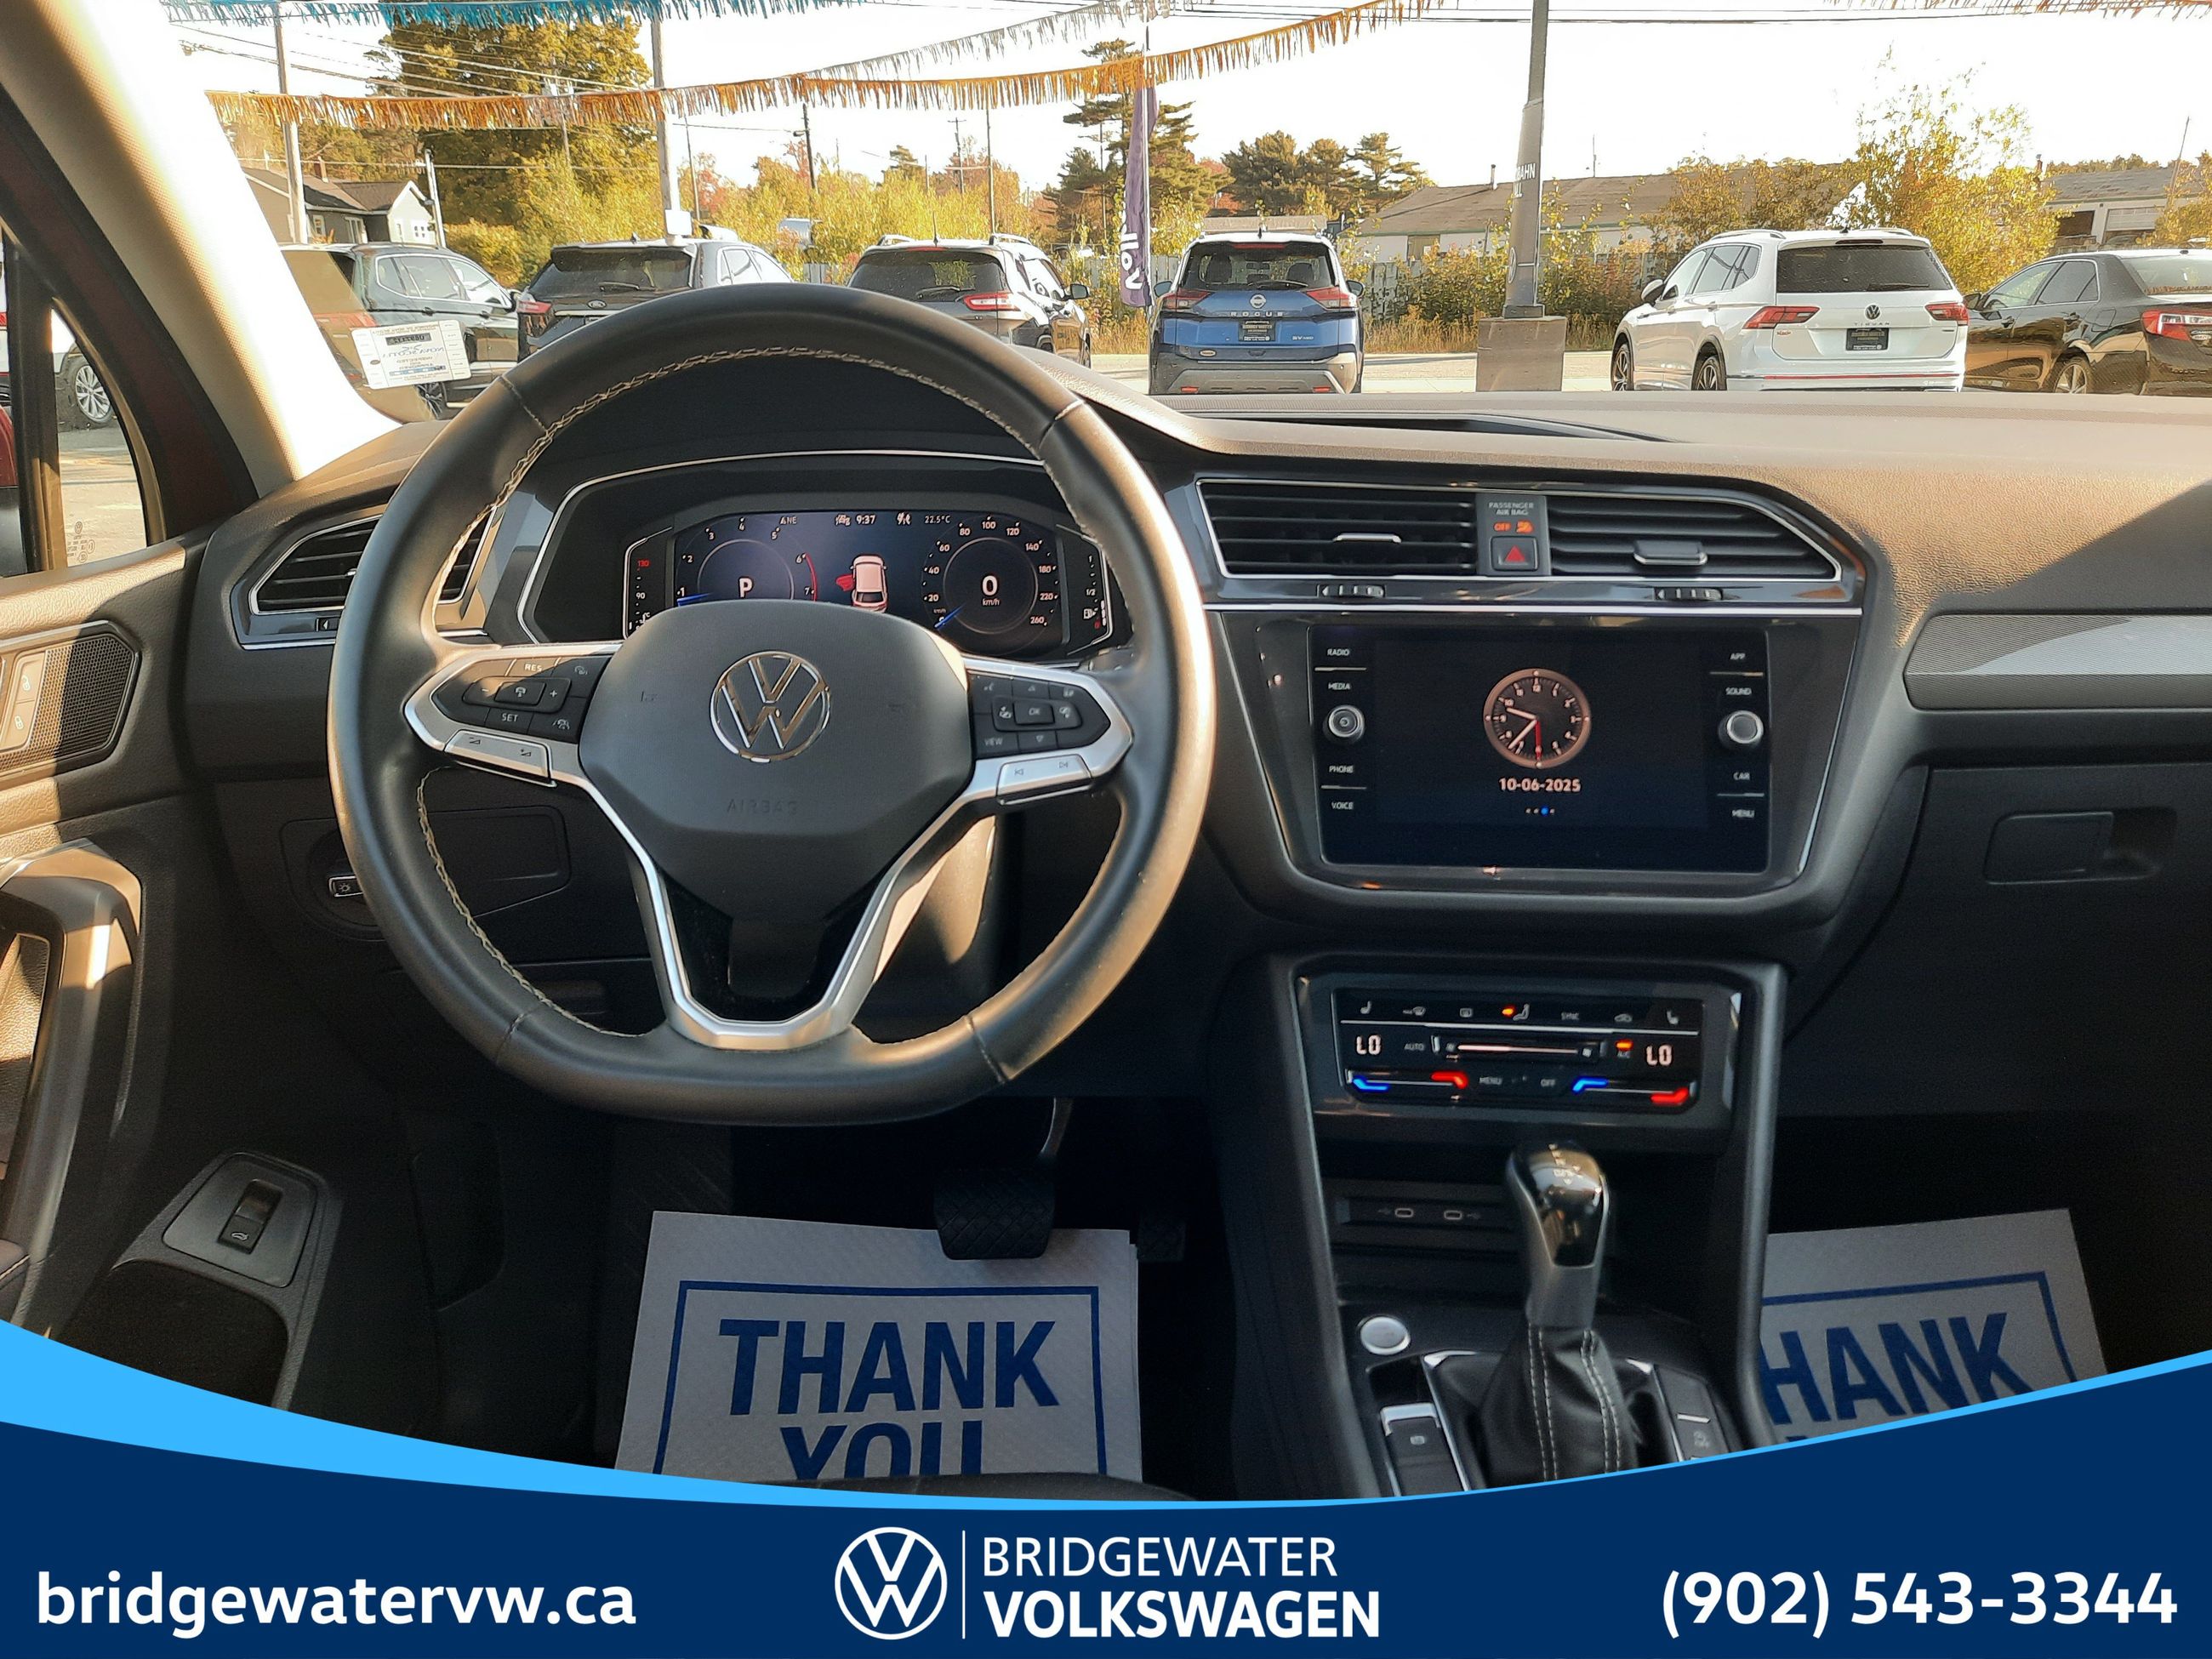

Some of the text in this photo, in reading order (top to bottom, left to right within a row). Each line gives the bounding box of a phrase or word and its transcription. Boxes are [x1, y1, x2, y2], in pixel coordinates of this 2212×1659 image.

[856, 514, 876, 525] 9:37
[924, 515, 951, 525] 22.5°C
[982, 521, 996, 529] 100
[1493, 522, 1511, 532] OFF
[709, 532, 715, 540] 3
[771, 532, 778, 540] 5
[959, 527, 971, 536] 80
[1006, 527, 1020, 536] 120
[939, 544, 950, 552] 60
[1025, 542, 1040, 551] 140
[687, 555, 693, 563] 2
[928, 566, 940, 574] 40
[738, 578, 754, 598] P
[982, 575, 998, 596] 0
[636, 591, 646, 600] 90
[927, 594, 939, 602] 20
[1040, 592, 1053, 601] 220
[982, 597, 1001, 607] km/h
[1327, 648, 1350, 657] RADIO
[1730, 653, 1746, 661] APP
[524, 664, 542, 672] RES
[1725, 687, 1753, 696] SOUND
[1028, 707, 1041, 716] OK
[501, 713, 519, 722] SET
[984, 737, 1004, 746] VIEW
[1733, 772, 1751, 781] CAR
[1498, 778, 1582, 792] 10-06-2025
[1331, 801, 1354, 810] VOICE
[1732, 810, 1755, 818] MENU
[1560, 1012, 1579, 1021] SYNC
[1355, 1035, 1382, 1056] LO
[1645, 1044, 1673, 1066] LO
[1479, 1077, 1503, 1086] MENU
[1540, 1078, 1556, 1087] OFF
[719, 1319, 1060, 1416] THANK
[1759, 1312, 2034, 1425] HANK
